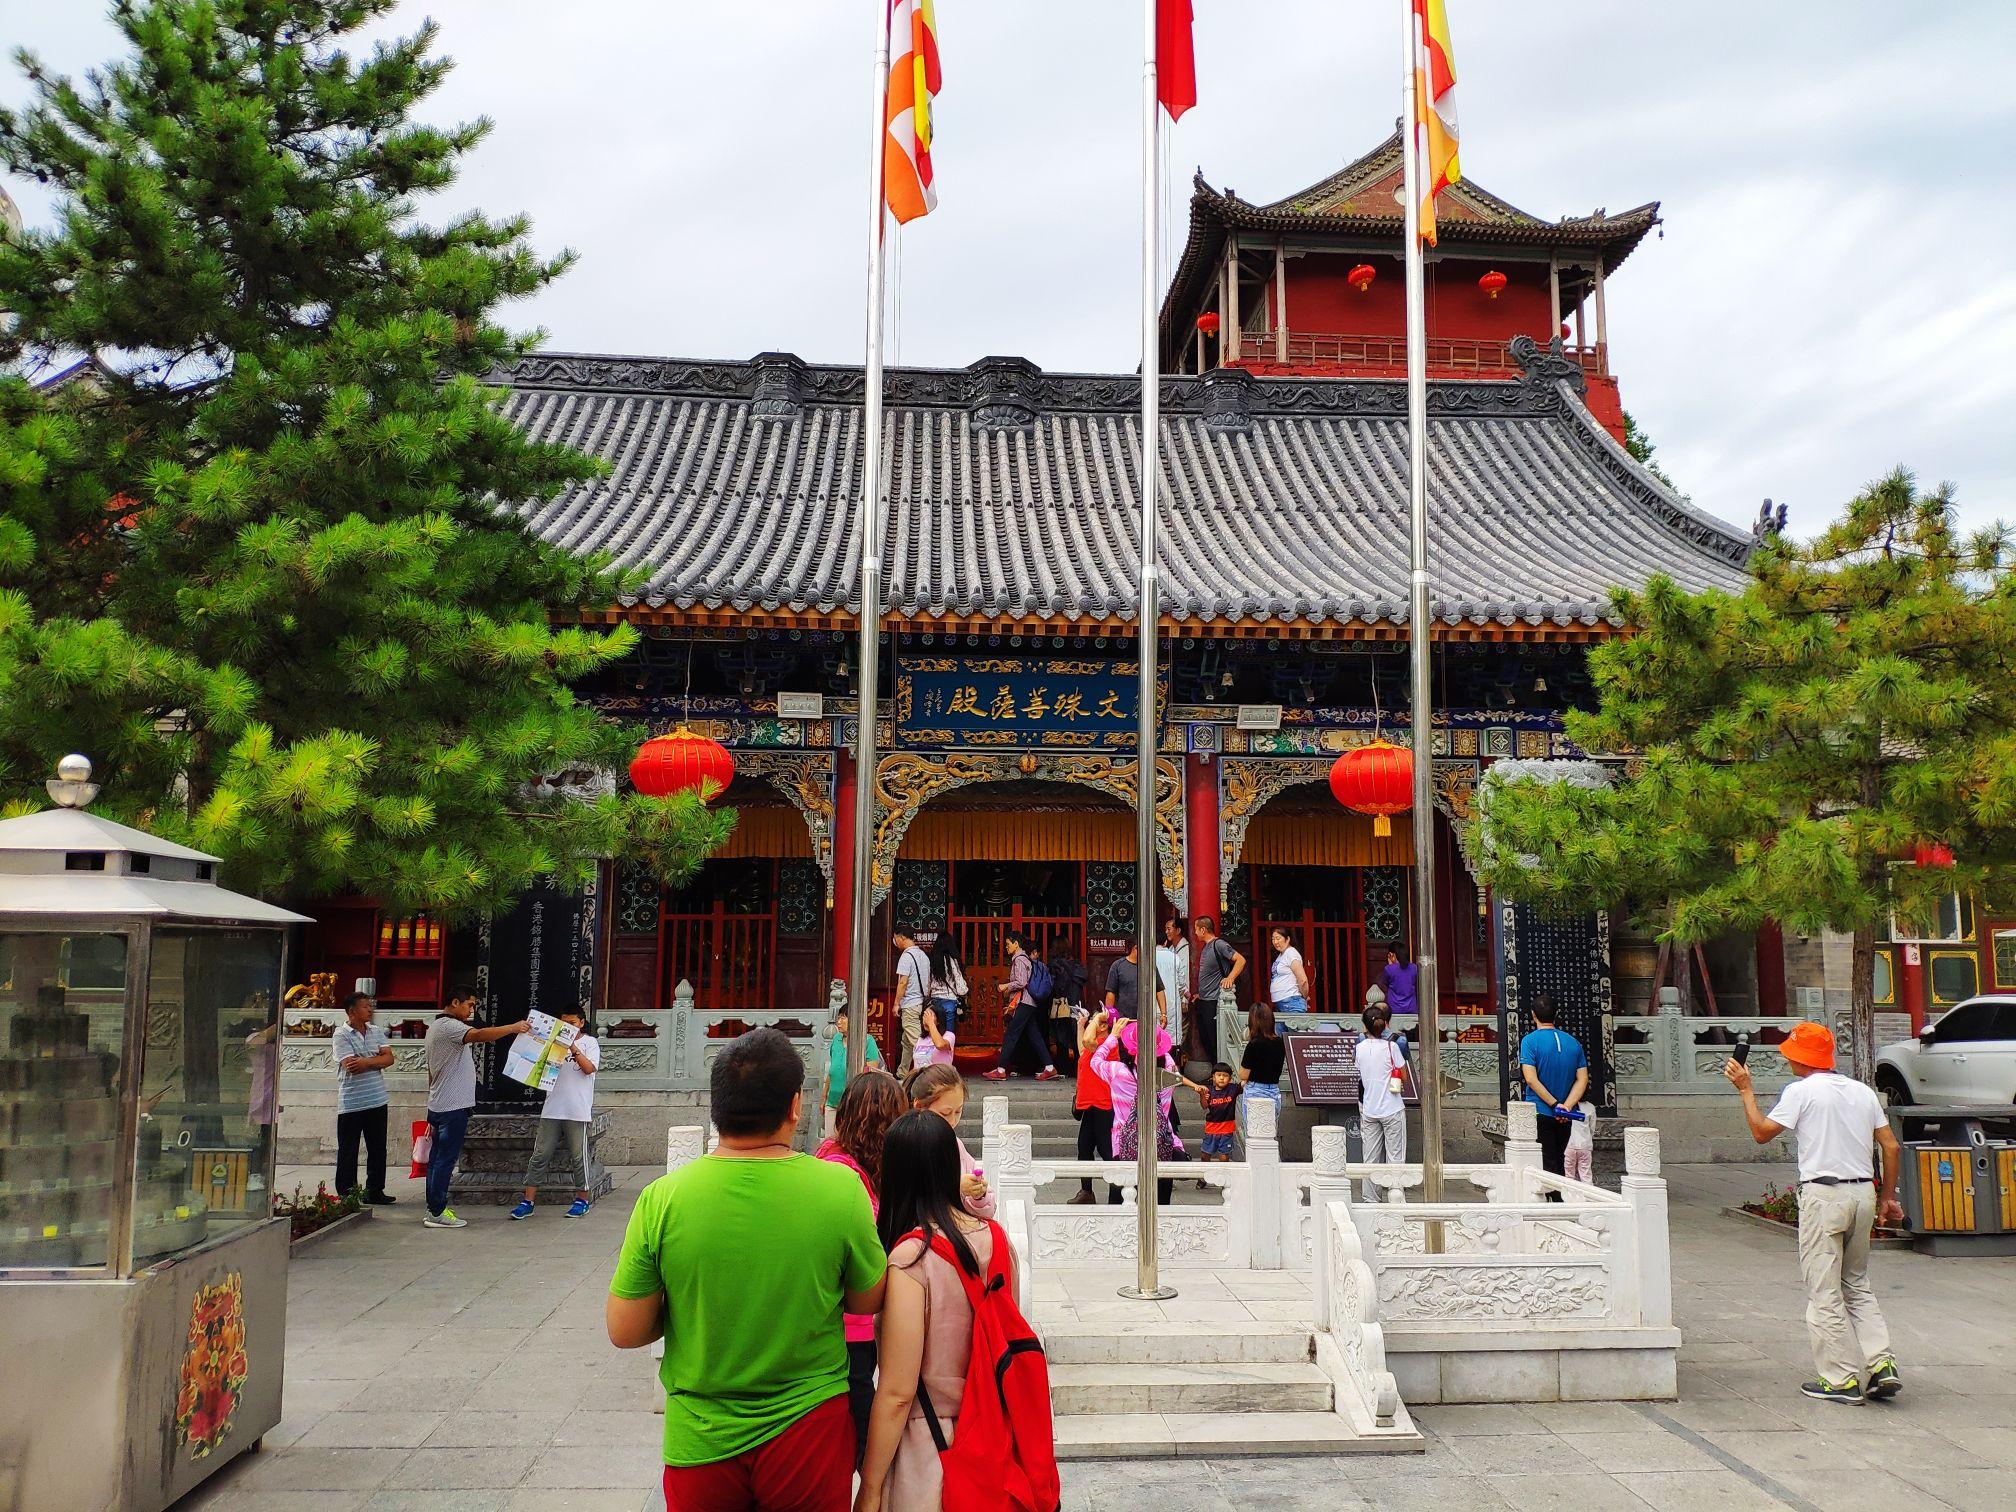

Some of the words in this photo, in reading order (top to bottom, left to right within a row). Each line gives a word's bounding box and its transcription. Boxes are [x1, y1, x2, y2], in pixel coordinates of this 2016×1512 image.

[946, 685, 1128, 722] 文殊菩薩殿
